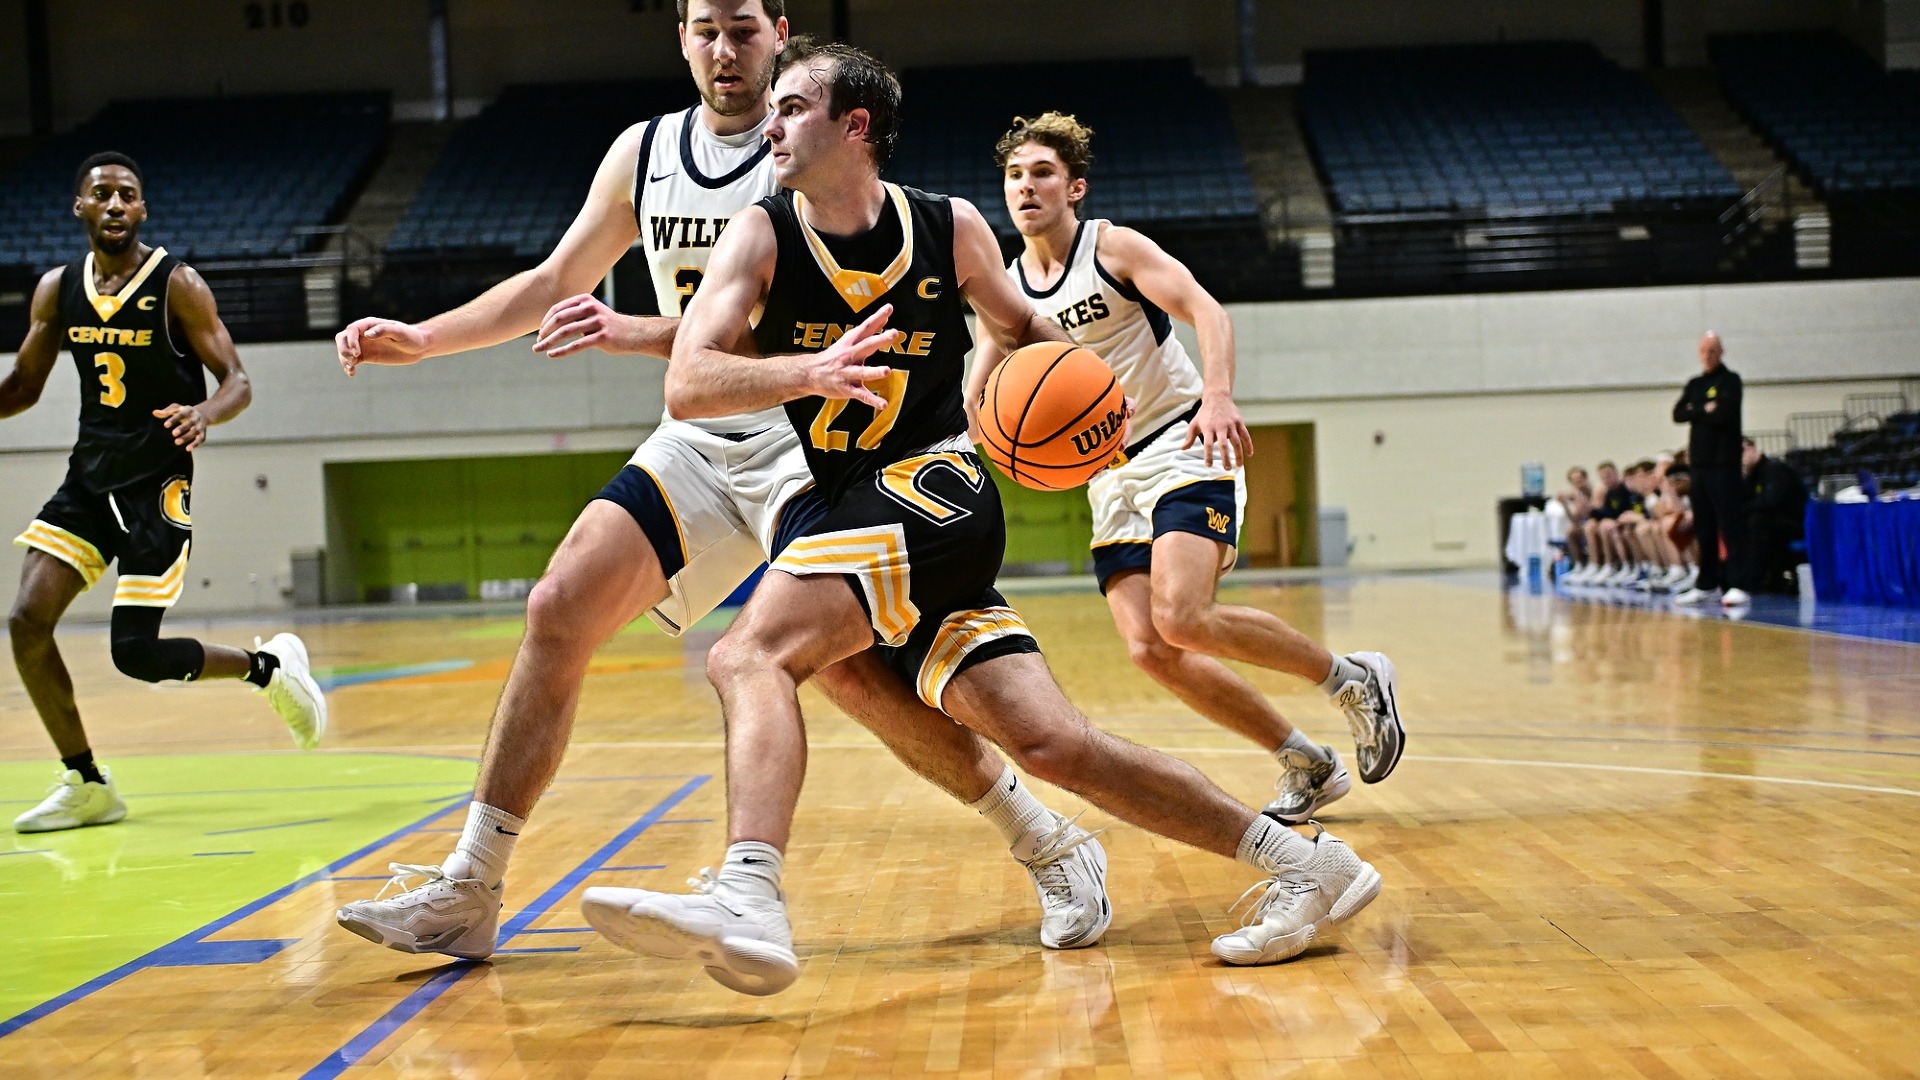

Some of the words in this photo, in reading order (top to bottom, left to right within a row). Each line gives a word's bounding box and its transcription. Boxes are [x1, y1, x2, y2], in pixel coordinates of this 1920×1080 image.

[245, 2, 308, 29] 210
[917, 277, 941, 299] C
[137, 296, 156, 310] C
[68, 326, 153, 346] CENTRE
[94, 352, 126, 408] 3
[1206, 507, 1230, 533] W
